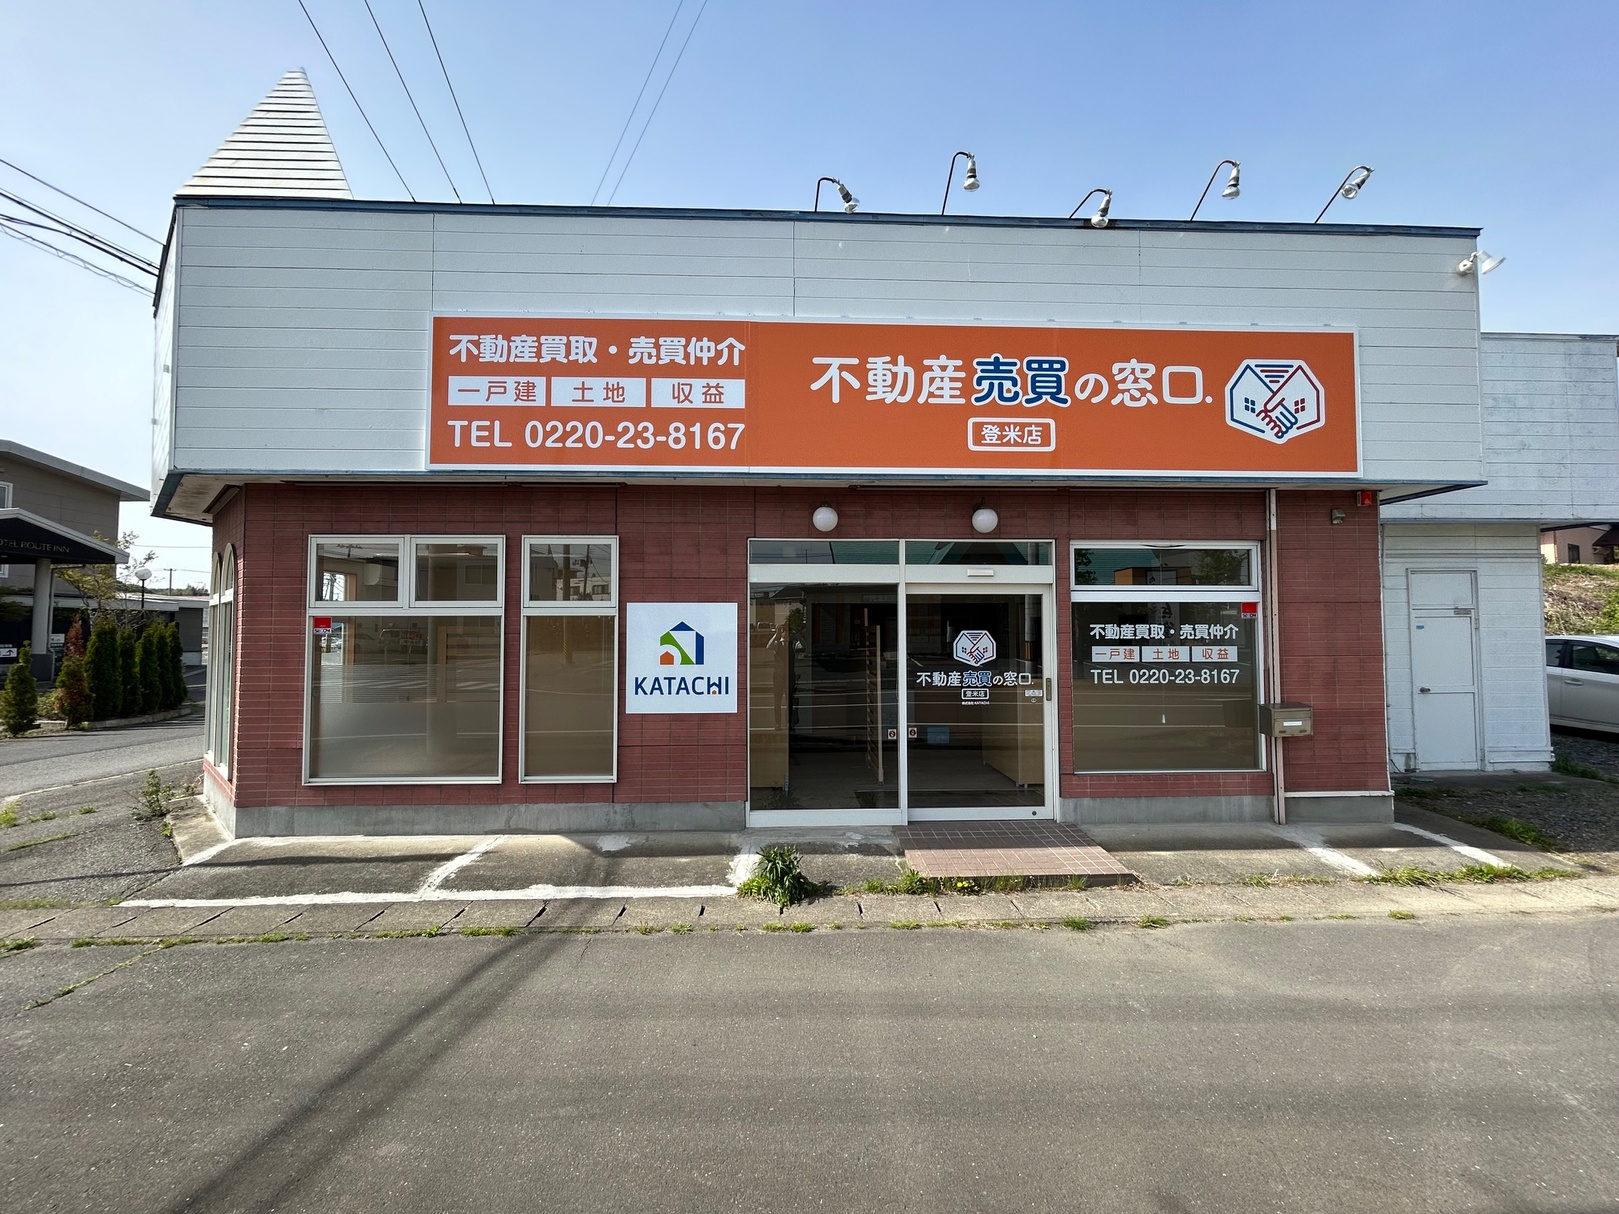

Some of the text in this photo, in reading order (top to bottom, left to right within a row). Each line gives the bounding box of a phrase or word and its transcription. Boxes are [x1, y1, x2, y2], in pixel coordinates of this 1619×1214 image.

[449, 334, 746, 366] 不動産買取・売買仲介
[457, 380, 725, 405] 一戸建 土地 収益
[447, 420, 746, 450] TEL 0220-23-8167
[980, 424, 1042, 446] 登米店
[1089, 623, 1239, 640] 不動産買取・売買仲介
[1095, 648, 1229, 660] 一戸建 土地 収益
[634, 676, 730, 696] KATACHI
[1090, 668, 1240, 685] TEL 0220-23-8167
